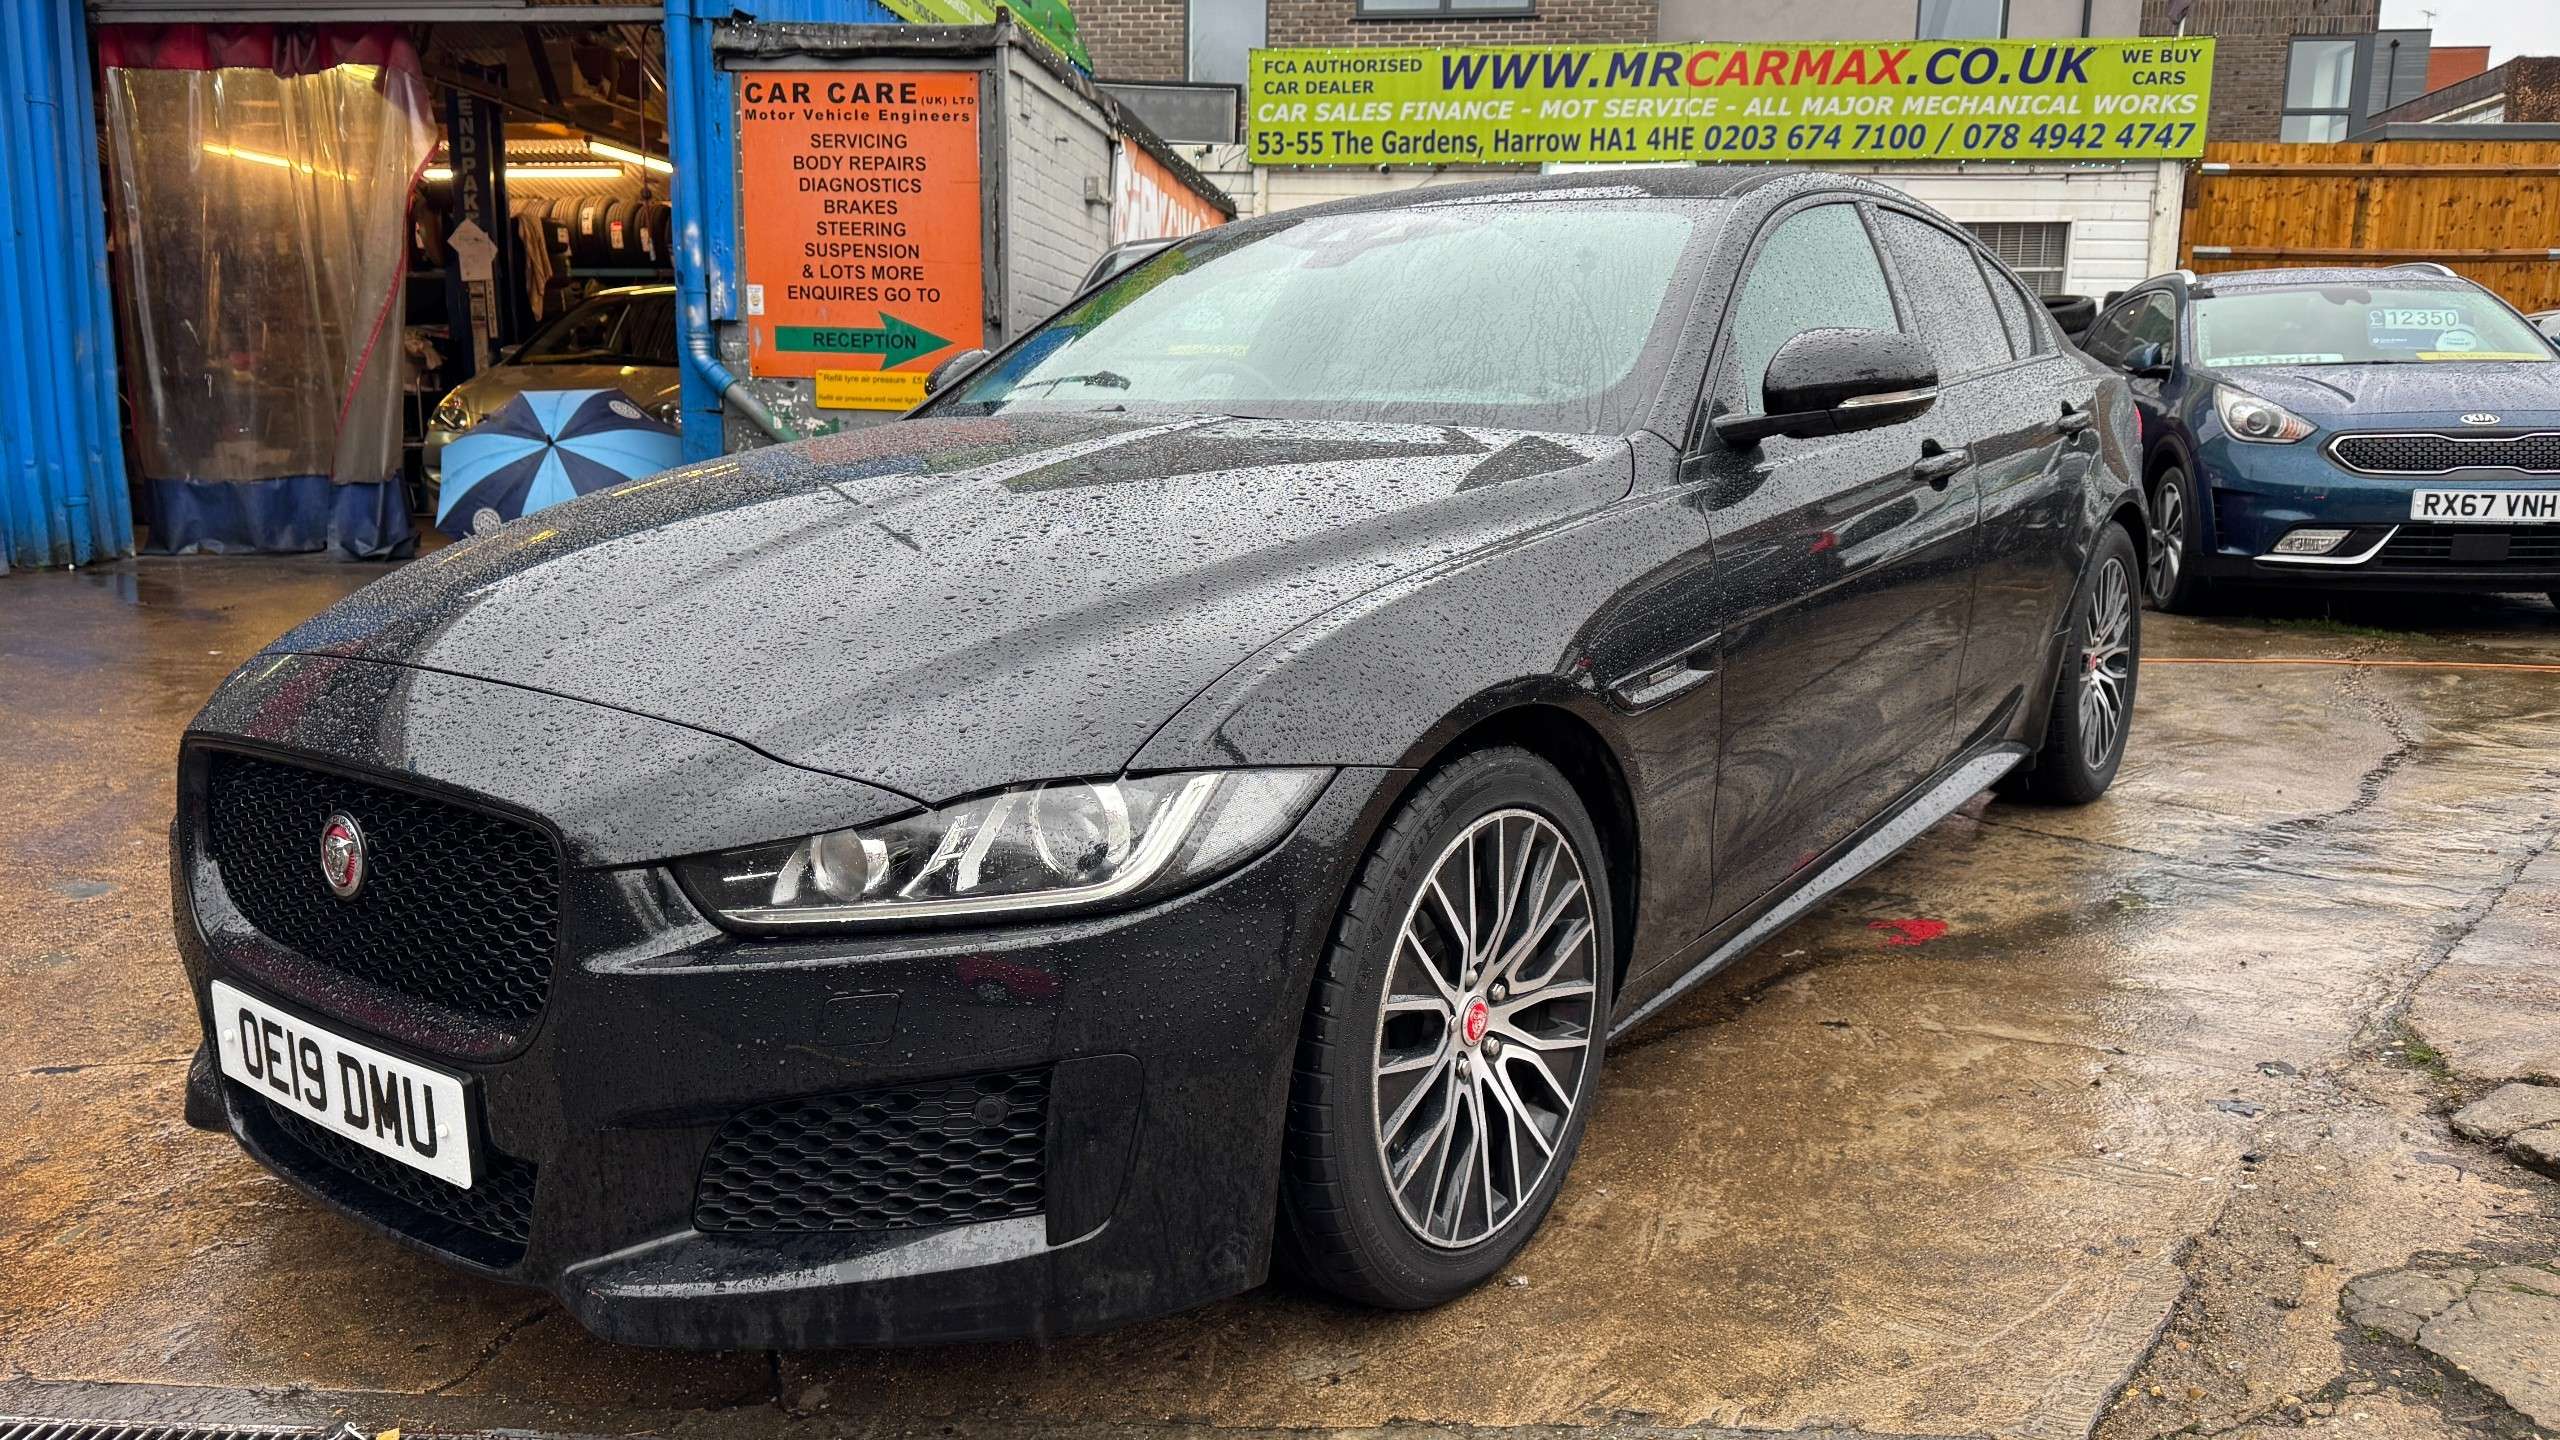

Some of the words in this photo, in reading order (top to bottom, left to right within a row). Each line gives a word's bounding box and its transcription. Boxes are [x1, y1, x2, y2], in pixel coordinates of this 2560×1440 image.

[2122, 49, 2153, 63] WE
[2160, 49, 2202, 63] BUY
[1264, 60, 1297, 74] FCA
[1302, 58, 1422, 74] AUTHORISED
[1441, 47, 2098, 90] WWW.MRCARMAX.CO.UK
[2132, 71, 2186, 85] CARS
[744, 82, 811, 104] CAR
[827, 82, 917, 104] CARE
[920, 96, 947, 106] (UK)
[952, 96, 975, 105] LTD
[1264, 80, 1299, 94] CAR
[1306, 80, 1374, 94] DEALER
[744, 109, 795, 121] Motor
[803, 109, 870, 121] Vehicle
[878, 109, 971, 124] Engineers
[1257, 103, 1307, 123] CAR
[1313, 102, 1392, 122] SALES
[1400, 100, 1514, 121] FINANCE
[1539, 99, 1598, 119] MOT
[1603, 98, 1718, 118] SERVICE
[1743, 97, 1792, 116] ALL
[1801, 96, 1894, 116] MAJOR
[1902, 95, 2081, 115] MECHANICAL
[2093, 94, 2198, 114] WORKS
[810, 133, 908, 149] SERVICING
[1257, 131, 1323, 155] 53-55
[1331, 130, 1373, 154] The
[1382, 129, 1484, 158] Gardens,
[1494, 129, 1581, 152] Harrow
[1589, 127, 1637, 151] HA1
[1647, 126, 1694, 151] 4HE
[1704, 124, 1777, 151] 0203
[1787, 124, 1842, 150] 674
[1851, 123, 1926, 149] 7100
[1934, 123, 1954, 154] /
[1963, 123, 2021, 150] 078
[2028, 123, 2106, 149] 4942
[2115, 123, 2196, 149] 4747
[793, 155, 843, 170] BODY
[849, 156, 927, 171] REPAIRS
[799, 177, 922, 193] DIAGNOSTICS
[823, 199, 898, 215] BRAKES
[816, 221, 906, 237] STEERING
[804, 243, 920, 259] SUSPENSION
[802, 265, 814, 279] &
[820, 265, 866, 280] LOTS
[871, 266, 924, 281] MORE
[787, 285, 878, 301] ENQUIRES
[884, 287, 911, 302] GO
[917, 288, 941, 303] TO
[812, 332, 917, 350] RECEPTION
[2463, 413, 2499, 423] KIA
[2423, 494, 2496, 516] RX67
[2506, 494, 2557, 518] VNH
[239, 1007, 328, 1112] OE19
[337, 1051, 437, 1158] DMU
